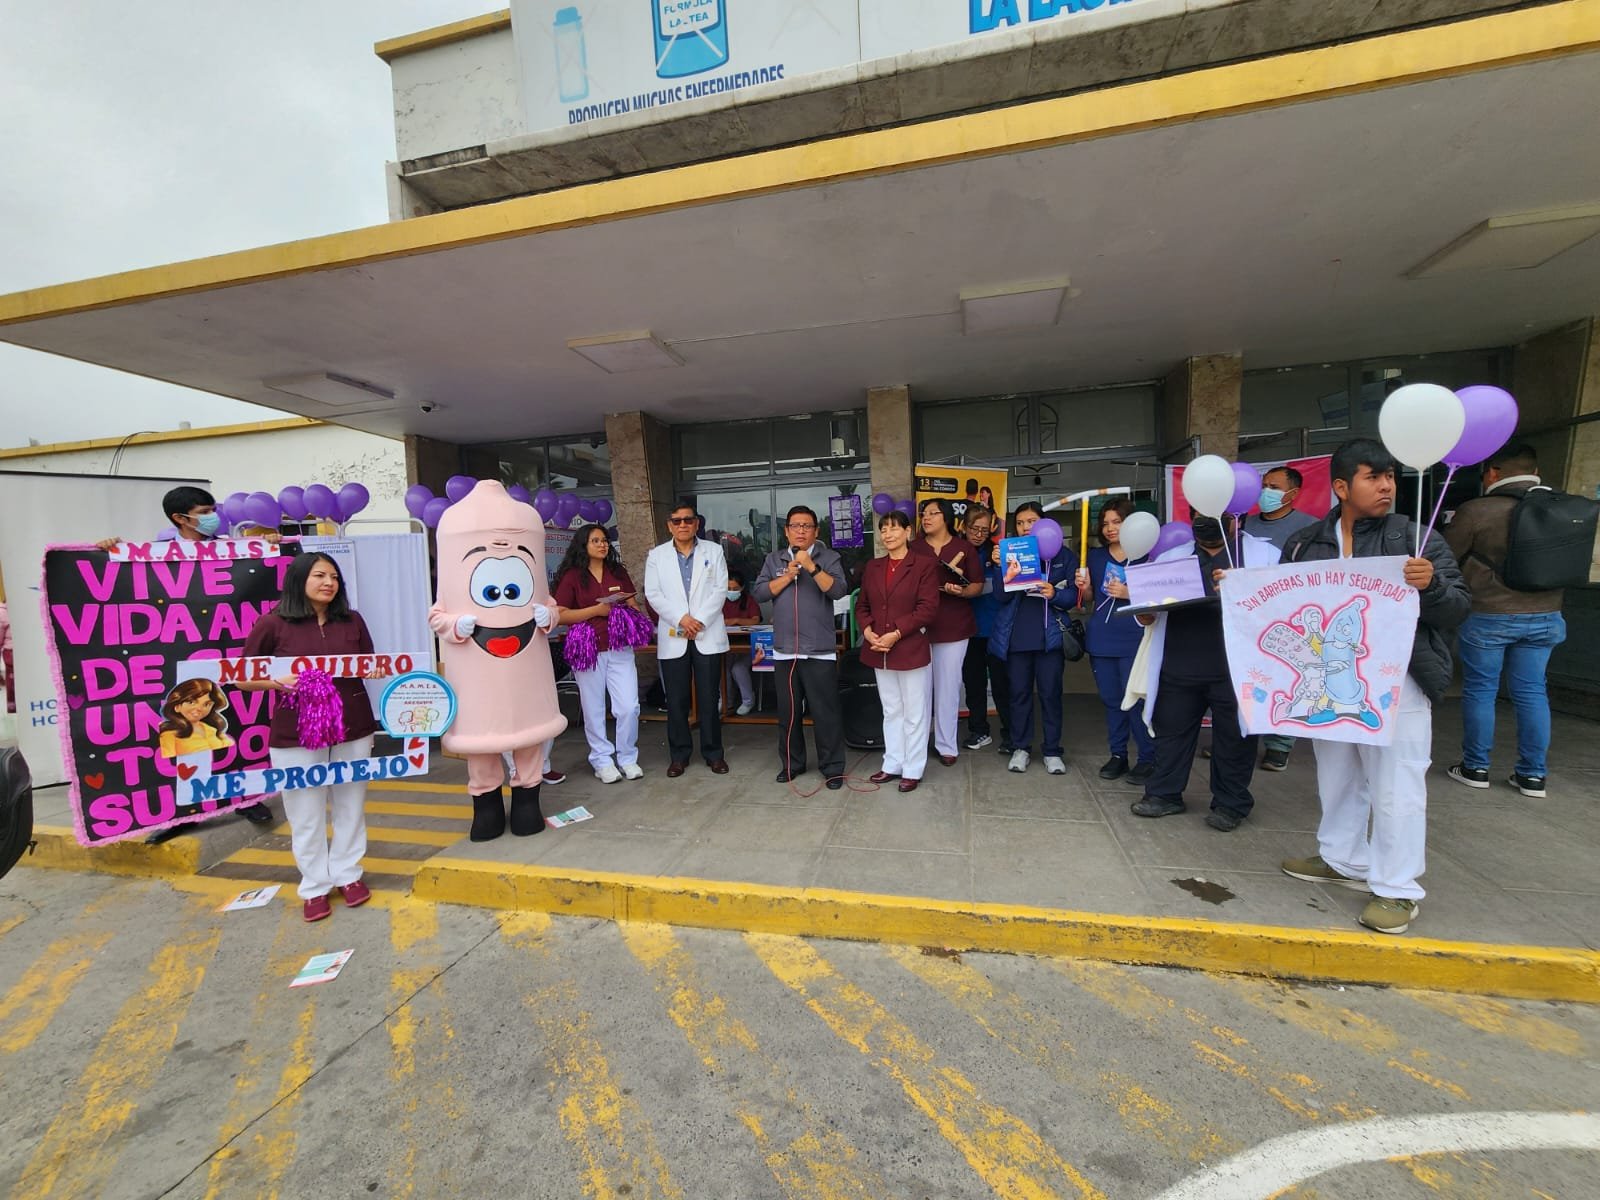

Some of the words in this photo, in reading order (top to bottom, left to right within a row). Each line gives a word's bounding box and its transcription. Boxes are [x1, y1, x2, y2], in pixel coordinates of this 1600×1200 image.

[76, 557, 235, 602] VIVE
[1257, 573, 1304, 602] BARRERAS
[1306, 573, 1321, 587] NO
[1325, 571, 1345, 586] HAY
[51, 602, 203, 646] VIDA
[81, 654, 165, 701] DE
[218, 658, 271, 683] ME
[291, 654, 413, 681] QUIERO
[190, 770, 246, 803] ME
[262, 755, 408, 793] PROTEJO
[89, 785, 176, 837] SU
